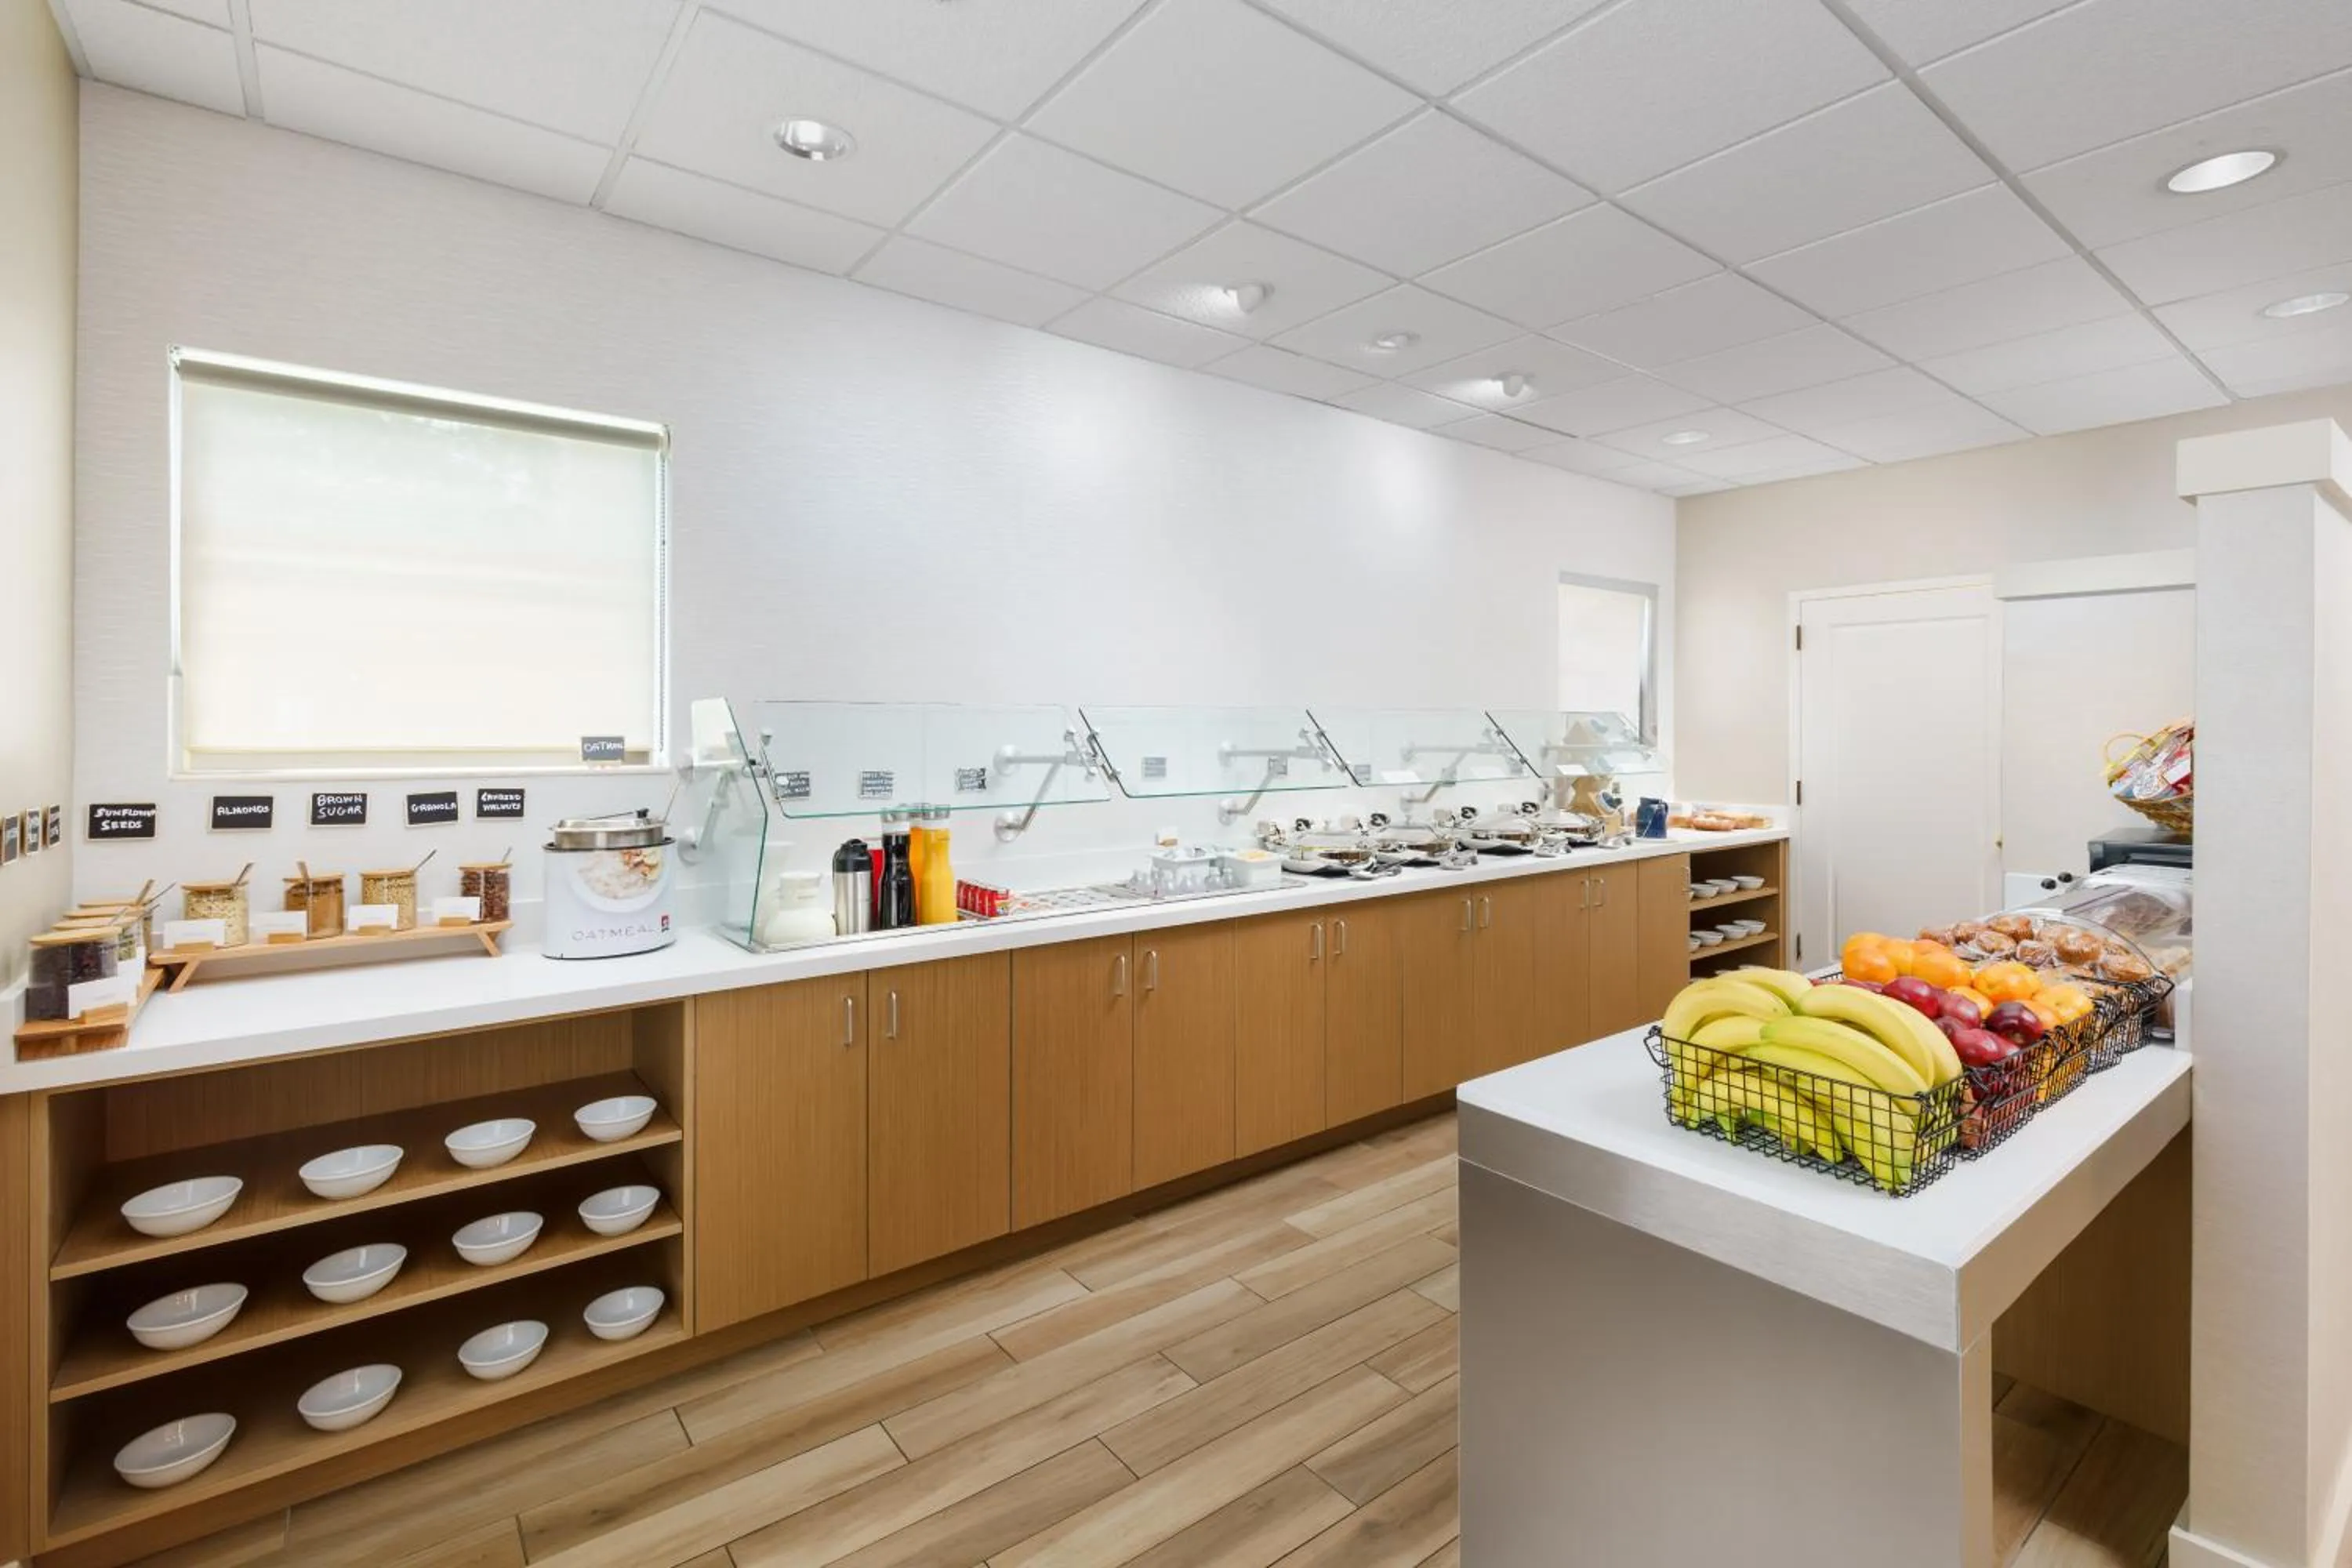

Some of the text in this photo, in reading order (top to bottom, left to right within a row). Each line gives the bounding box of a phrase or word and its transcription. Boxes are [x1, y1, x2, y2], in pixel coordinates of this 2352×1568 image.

[317, 794, 363, 807] BROWN
[216, 805, 270, 816] ALMONDS
[317, 805, 363, 819] SUGAR
[411, 802, 457, 813] GRANOLA
[100, 819, 143, 831] SEEDS
[571, 924, 657, 942] OATMEAL
